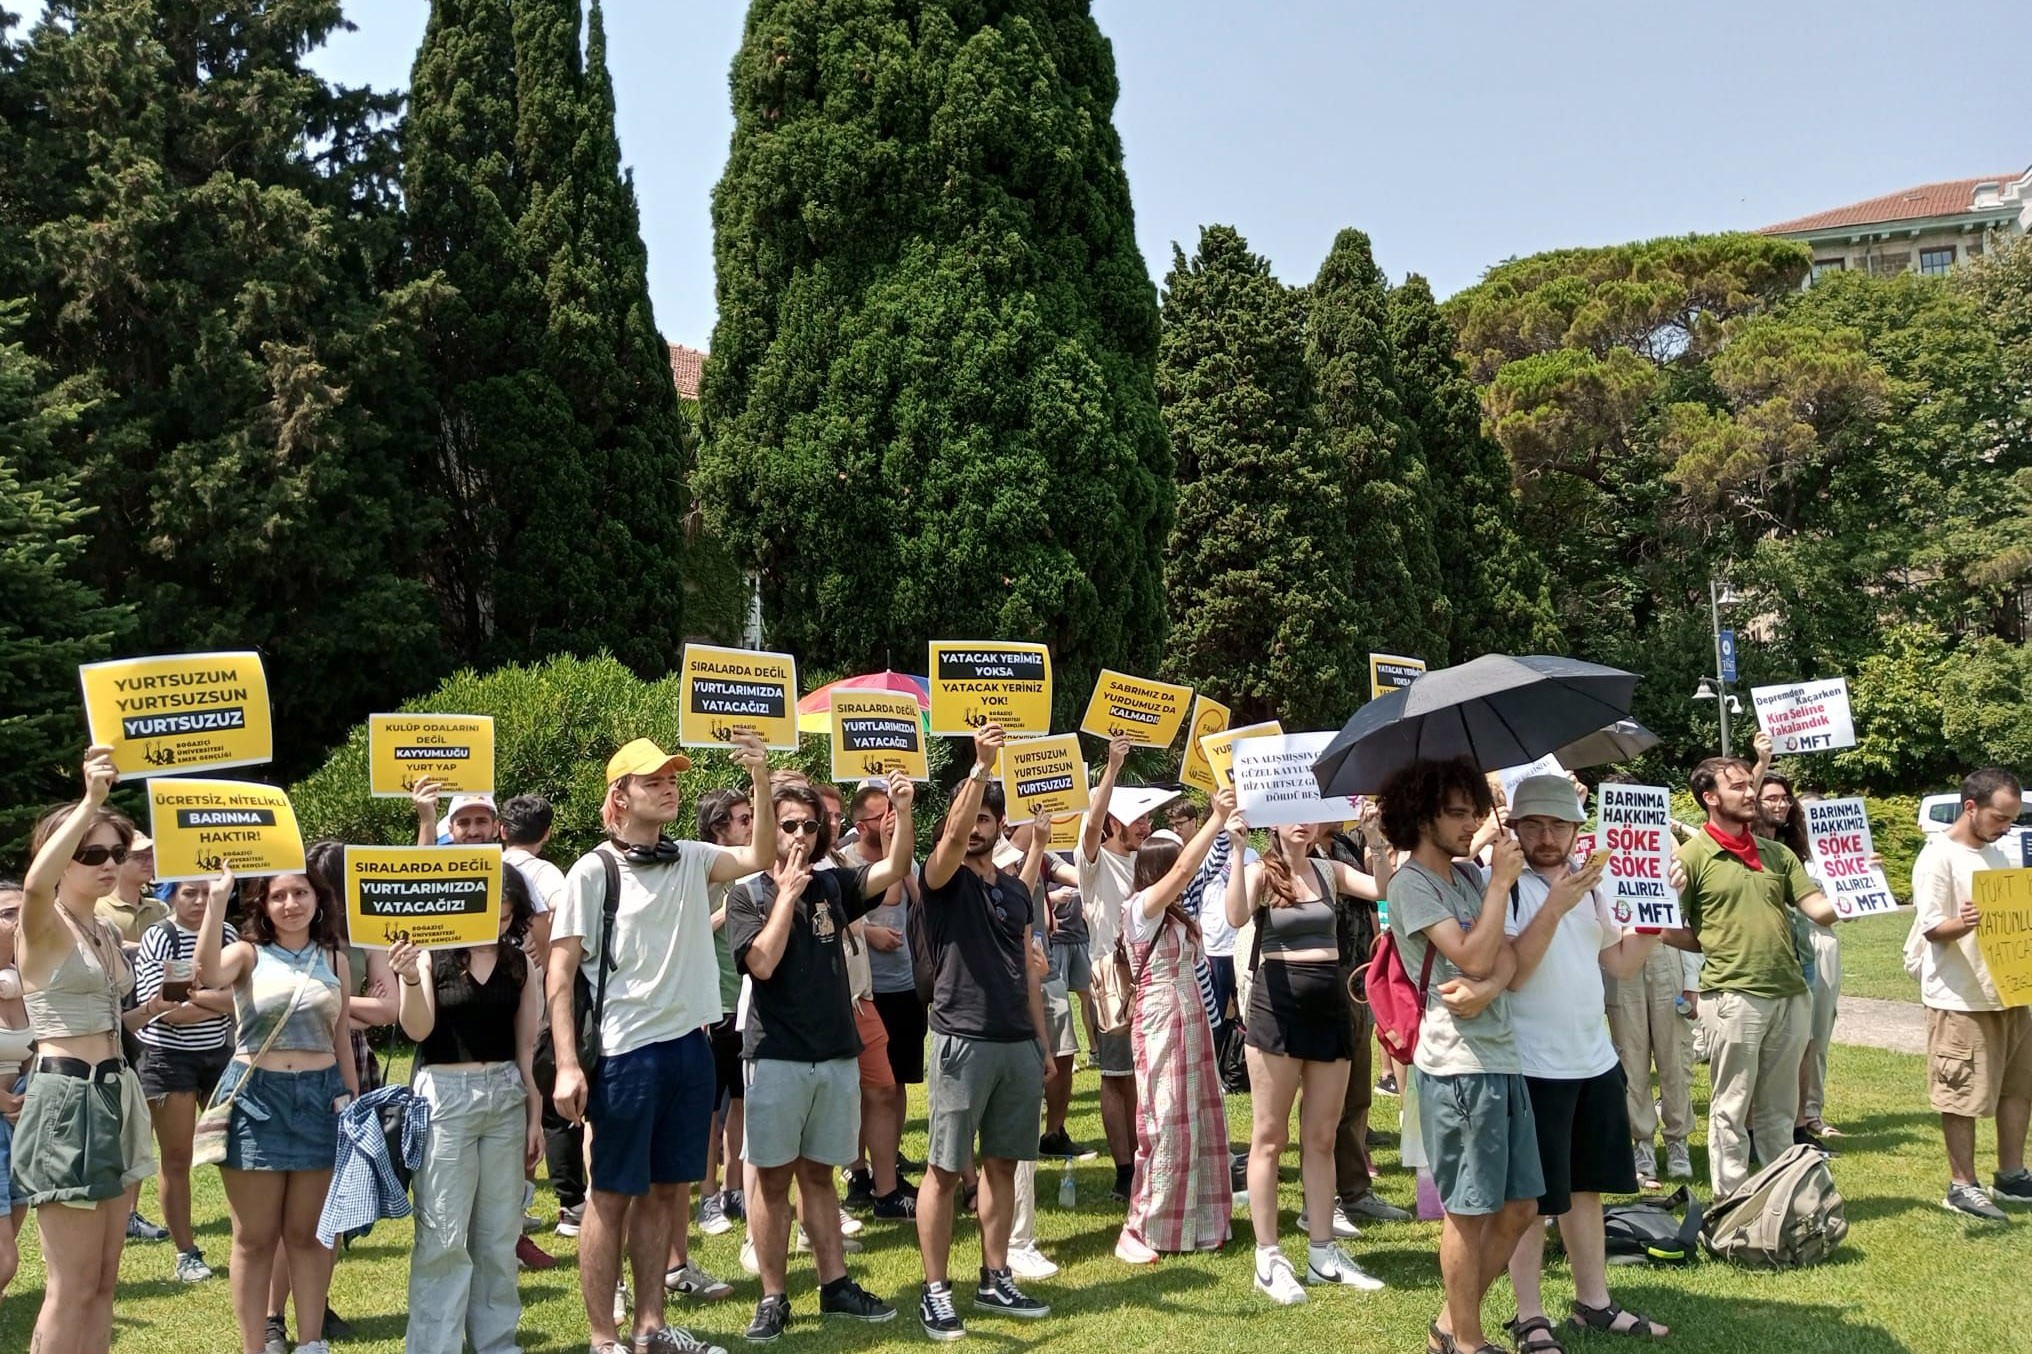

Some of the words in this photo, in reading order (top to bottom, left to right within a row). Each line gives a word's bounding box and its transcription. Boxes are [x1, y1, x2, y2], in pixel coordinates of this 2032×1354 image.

[941, 653, 998, 664] YATACAK
[1000, 652, 1042, 665] YERİMİZ
[690, 661, 751, 676] SIRALARDA
[755, 666, 787, 679] DEĞİL
[975, 666, 1014, 677] YOKSA
[114, 670, 237, 692] YURTSUZUM
[693, 680, 784, 698] YURTLARIMIZDA
[942, 683, 998, 693] YATACAK
[1000, 681, 1042, 693] YERİNİZ
[1110, 681, 1159, 699] SABRIMIZ
[1161, 693, 1175, 702] DA
[1756, 688, 1805, 706] Depremden
[1795, 686, 1841, 705] Kaçarken
[115, 688, 247, 712] YURTSUZSUN
[702, 699, 769, 714] YATACAĞIZ!
[981, 696, 1008, 706] YOK!
[1103, 692, 1161, 711] YURDUMUZ
[1162, 705, 1177, 714] DA
[837, 703, 894, 714] SIRALARDA
[896, 704, 917, 717] DEĞİL
[1110, 706, 1161, 724] KALMADI!
[1766, 711, 1789, 724] Kira
[1789, 703, 1825, 719] Seline
[124, 710, 243, 736] YURTSUZUZ
[385, 723, 420, 732] KULÜP
[423, 724, 480, 732] ODALARINI
[843, 720, 916, 734] YURTLARIMIZDA
[1768, 715, 1830, 737] Yakalandık
[176, 739, 211, 749] BOĞAZİÇİ
[416, 734, 447, 744] DEĞİL
[853, 736, 908, 748] YATACAĞIZ!
[1800, 733, 1832, 749] MFT
[177, 744, 224, 755] ÜNİVERSİTESİ
[199, 752, 232, 762] GENÇLİĞİ
[396, 748, 468, 758] KAYYUMLUĞU
[1014, 749, 1067, 764] YURTSUZUM
[1240, 756, 1259, 765] SEN
[1262, 752, 1313, 764] ALIŞMIŞSIN
[407, 763, 433, 771] YURT
[436, 763, 457, 771] YAP
[1014, 762, 1073, 778] YURTSUZSUN
[1241, 768, 1272, 778] GÜZEL
[1017, 778, 1072, 795] YURTSUZUZ
[1243, 781, 1259, 791] BİZ
[1260, 779, 1304, 790] YURTSUZ
[155, 793, 226, 806] ÜCRETSİZ,
[229, 793, 287, 807] NİTELİKLİ
[1265, 791, 1300, 802] DÖRDÜ
[1604, 790, 1665, 809] BARINMA
[189, 811, 261, 824] BARINMA
[1603, 808, 1667, 826] HAKKIMIZ
[1810, 803, 1861, 819] BARINMA
[1811, 818, 1865, 834] HAKKIMIZ
[200, 831, 261, 843] HAKTIR!
[1606, 824, 1661, 851] SÖKE
[1818, 832, 1863, 855] SÖKE
[355, 861, 443, 873] SIRALARDA
[448, 858, 493, 872] DEĞİL
[1610, 851, 1661, 878] SÖKE
[1824, 854, 1869, 877] SÖKE
[361, 881, 486, 894] YURTLARIMIZDA
[1617, 881, 1665, 897] ALIRIZ!
[1835, 876, 1877, 893] ALIRIZ!
[1978, 875, 2014, 903] YURT
[373, 900, 465, 913] YATACAĞIZ!
[1855, 892, 1889, 912] MFT
[1637, 902, 1674, 924] MFT
